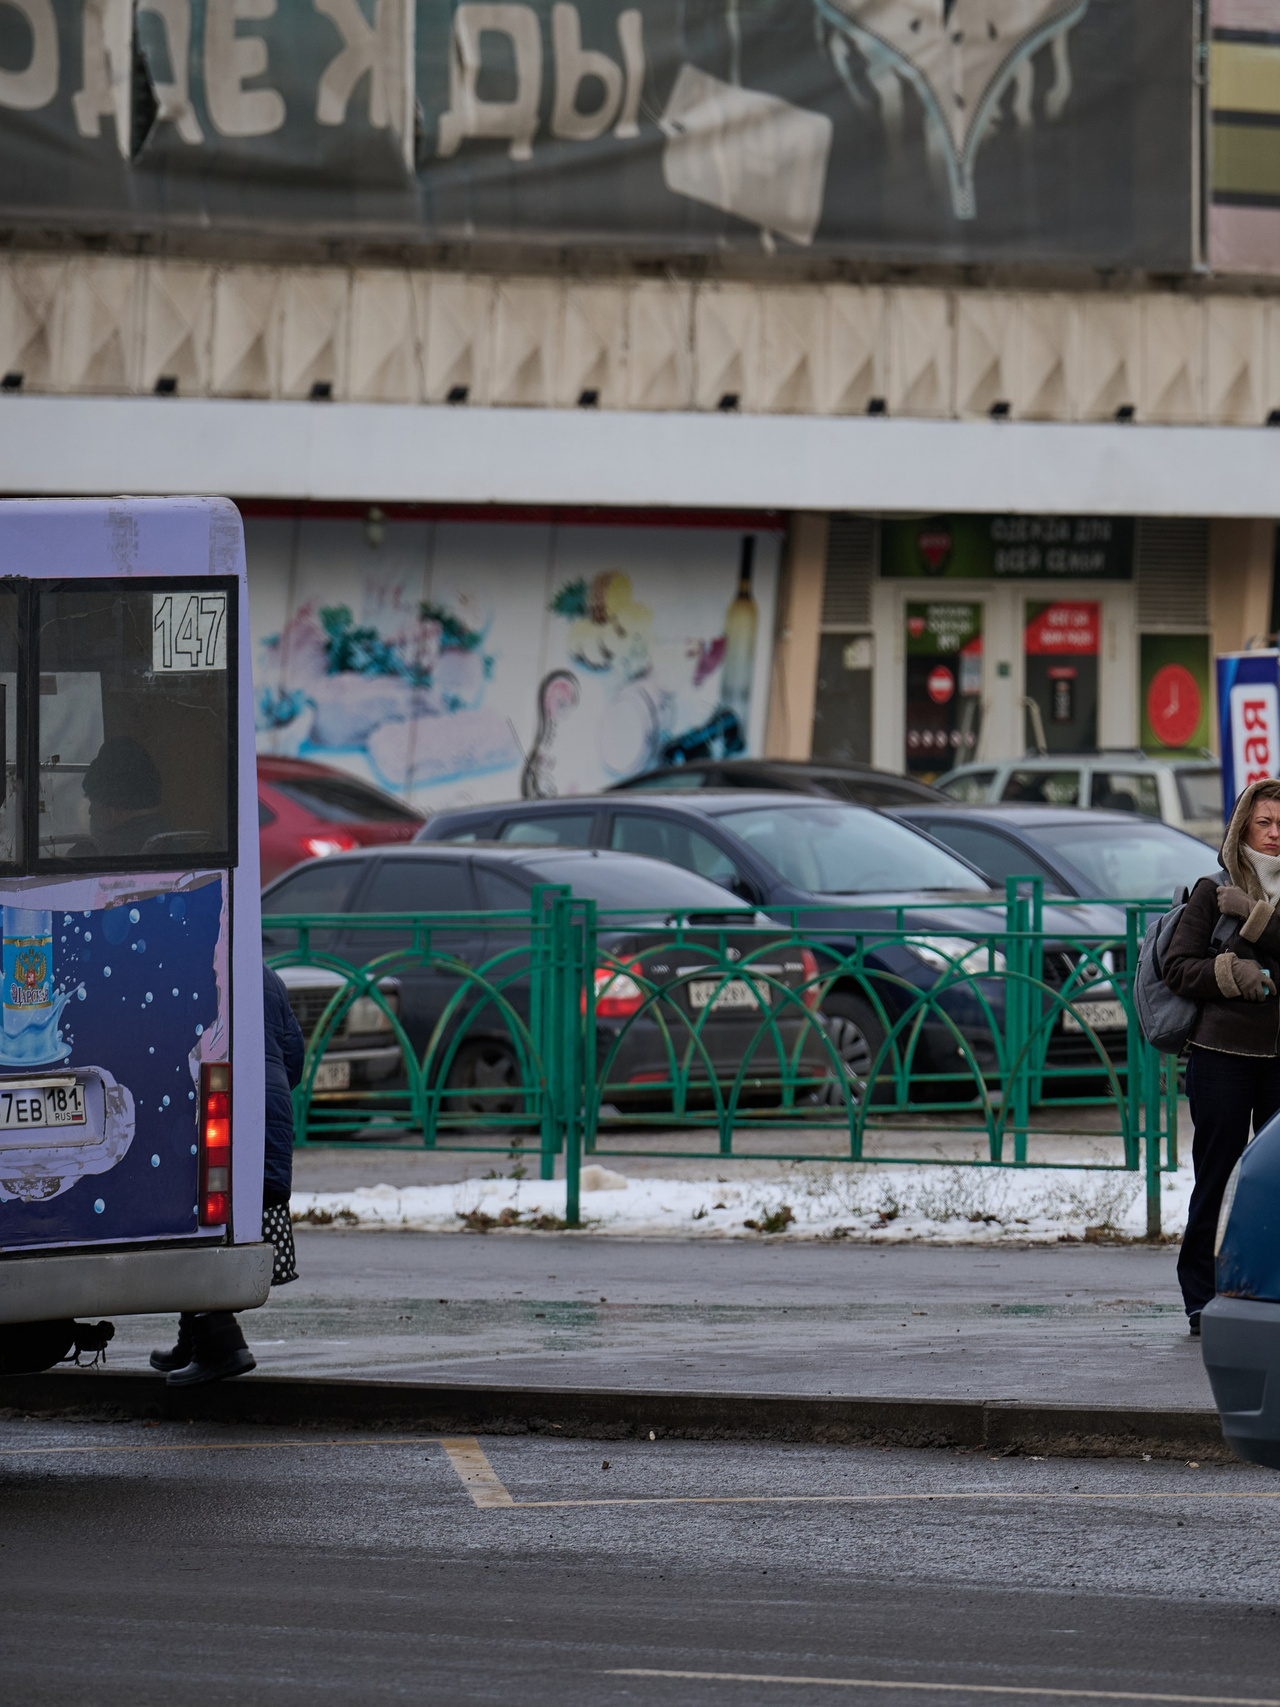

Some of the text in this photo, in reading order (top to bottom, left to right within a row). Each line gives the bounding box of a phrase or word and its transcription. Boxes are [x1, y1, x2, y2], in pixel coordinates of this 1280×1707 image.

[154, 596, 226, 668] 147
[47, 1088, 78, 1112] 181
[55, 1112, 71, 1121] RUS
